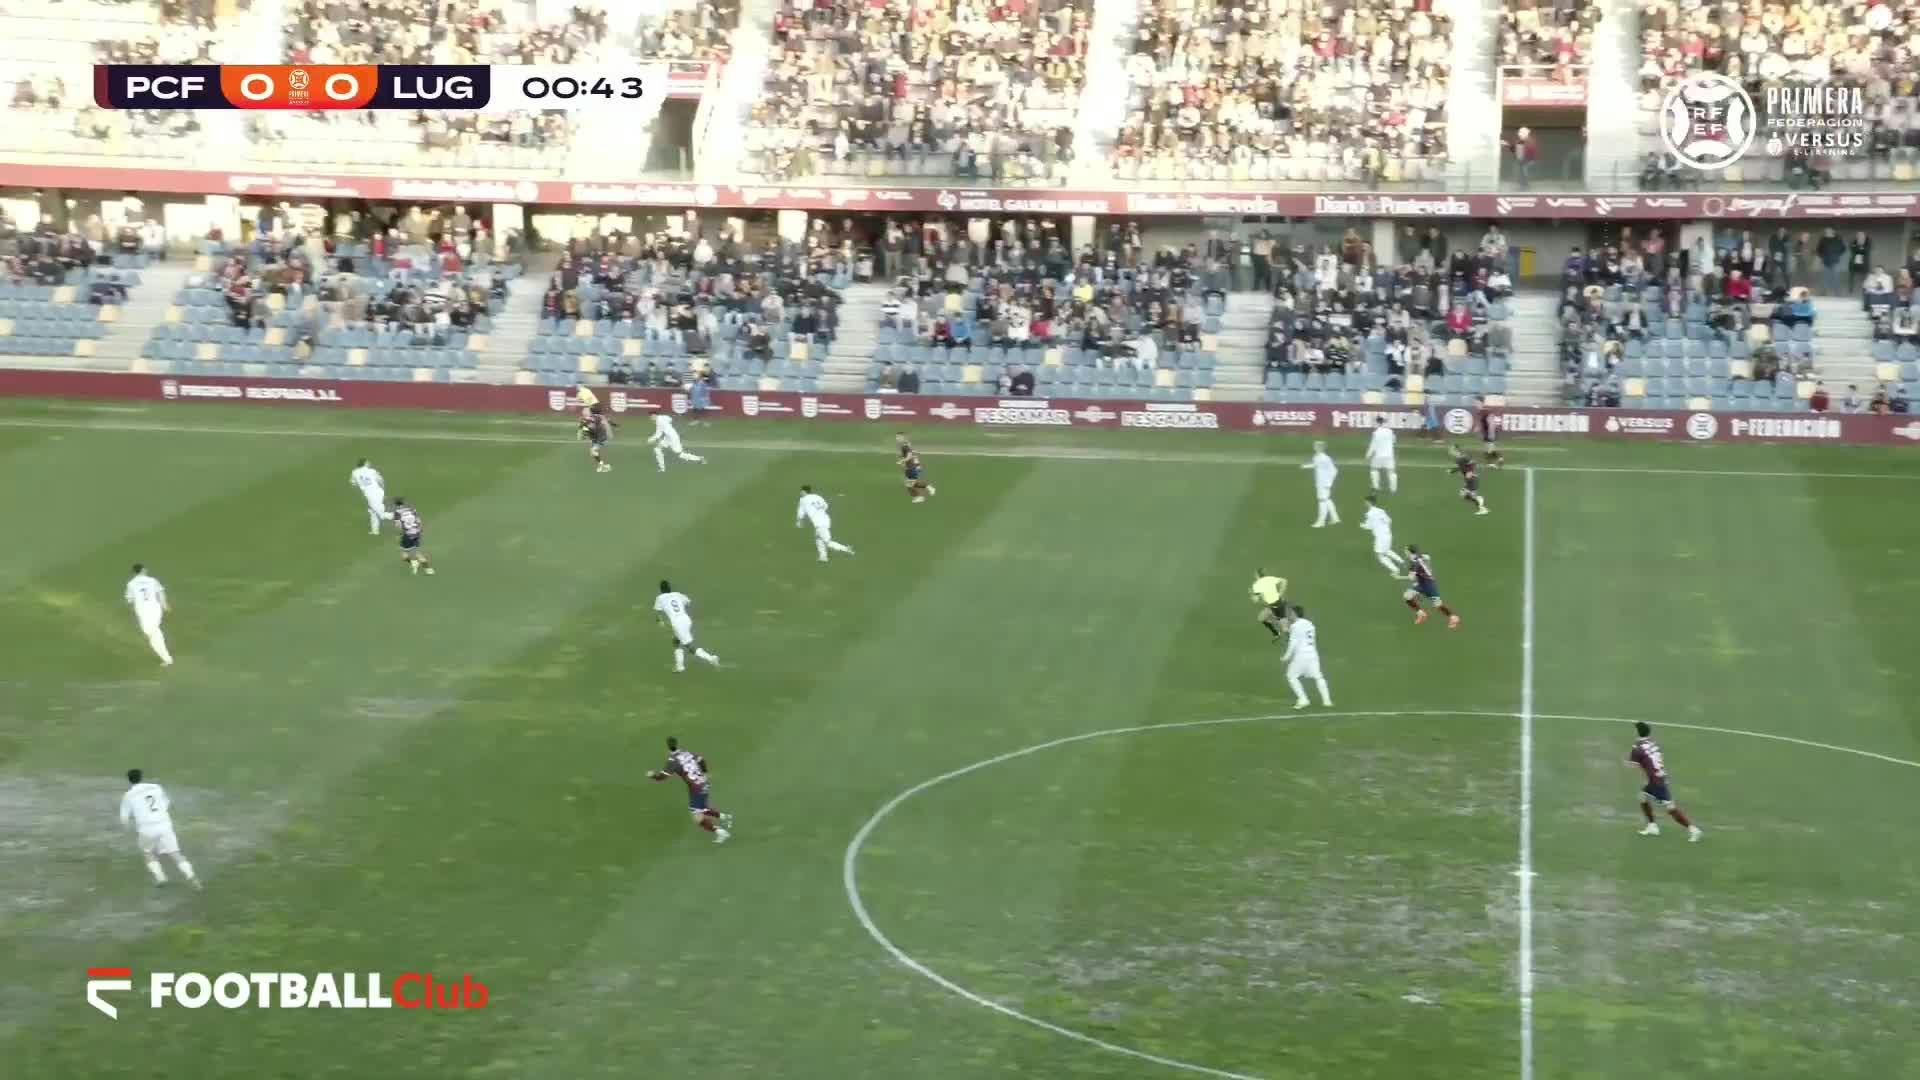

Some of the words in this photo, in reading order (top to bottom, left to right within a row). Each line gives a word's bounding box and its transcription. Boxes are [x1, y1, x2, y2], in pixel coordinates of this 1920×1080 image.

[975, 408, 1073, 425] PESCAMAR
[1121, 411, 1219, 429] PESCAMAR
[144, 795, 160, 812] 2
